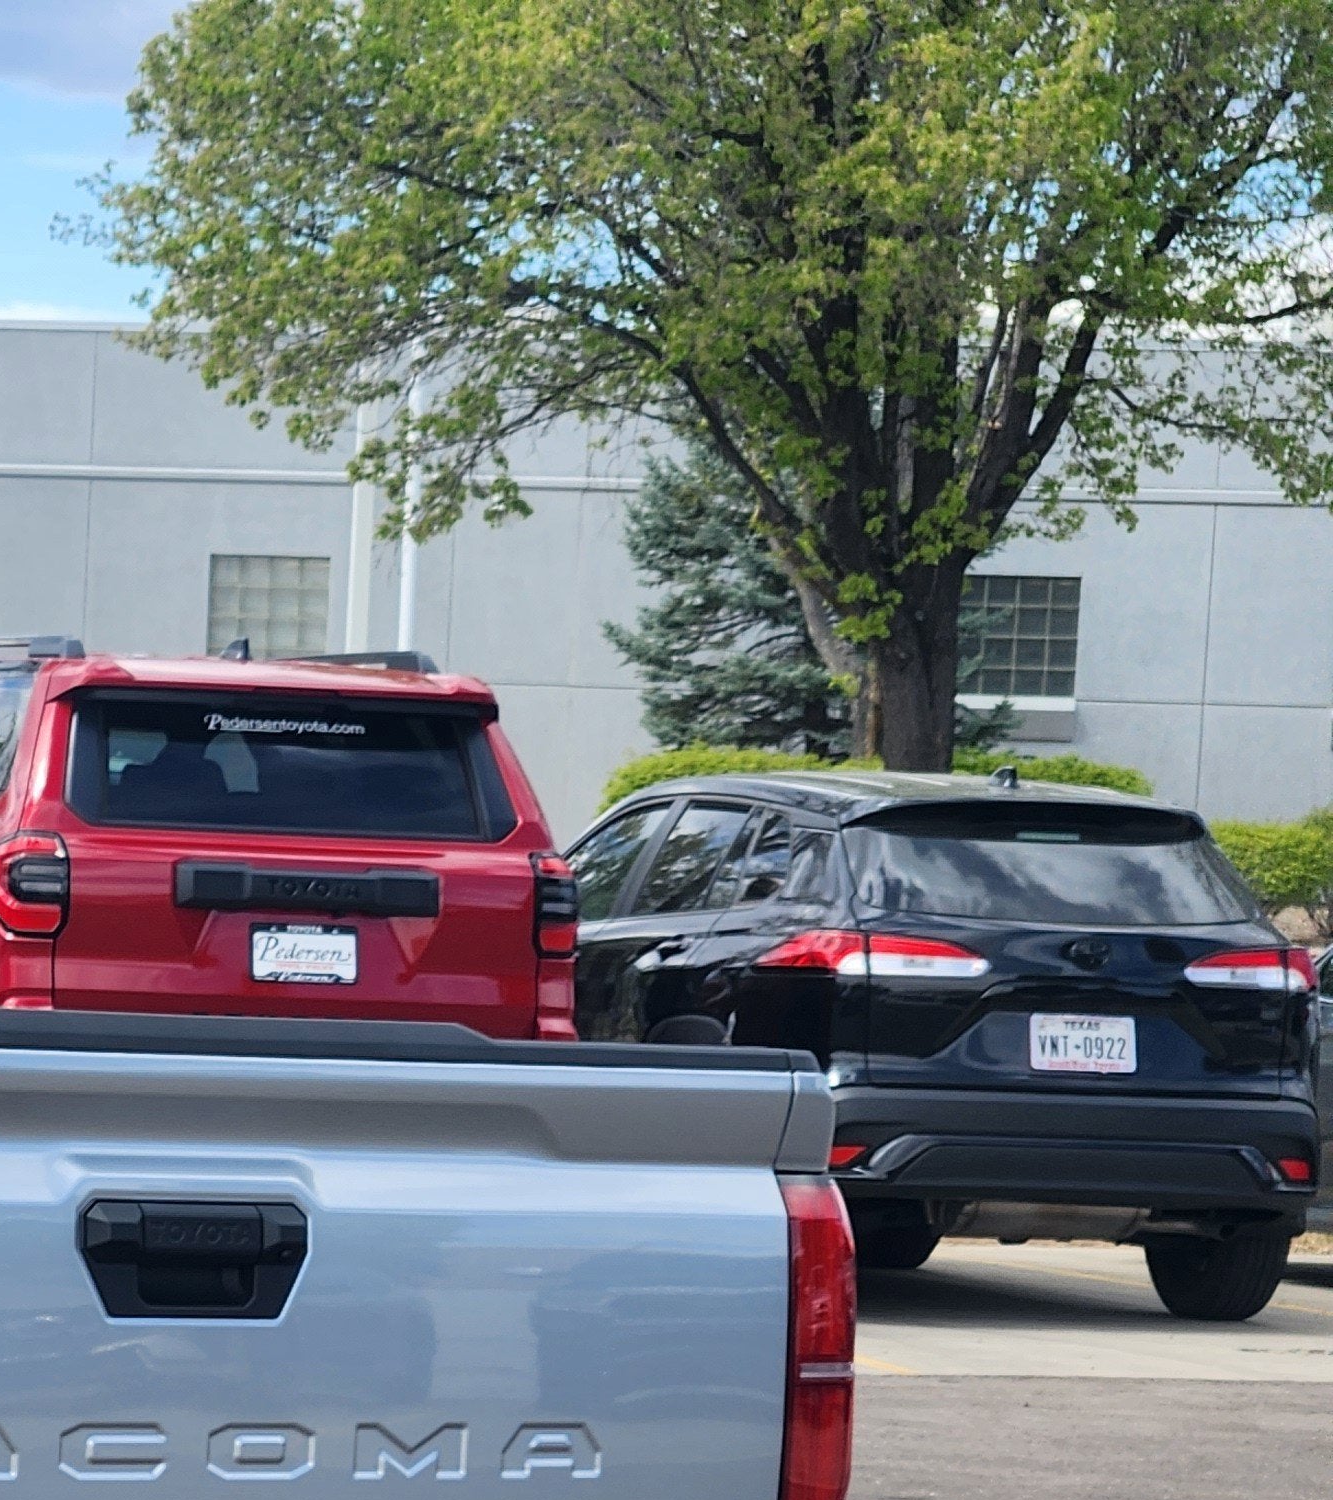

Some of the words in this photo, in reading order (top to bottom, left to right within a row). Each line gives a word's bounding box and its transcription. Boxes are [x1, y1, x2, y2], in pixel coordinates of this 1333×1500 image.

[204, 713, 366, 734] Pedersentoyota.com
[255, 936, 352, 962] Pedersen
[1063, 1021, 1101, 1031] TEXAS
